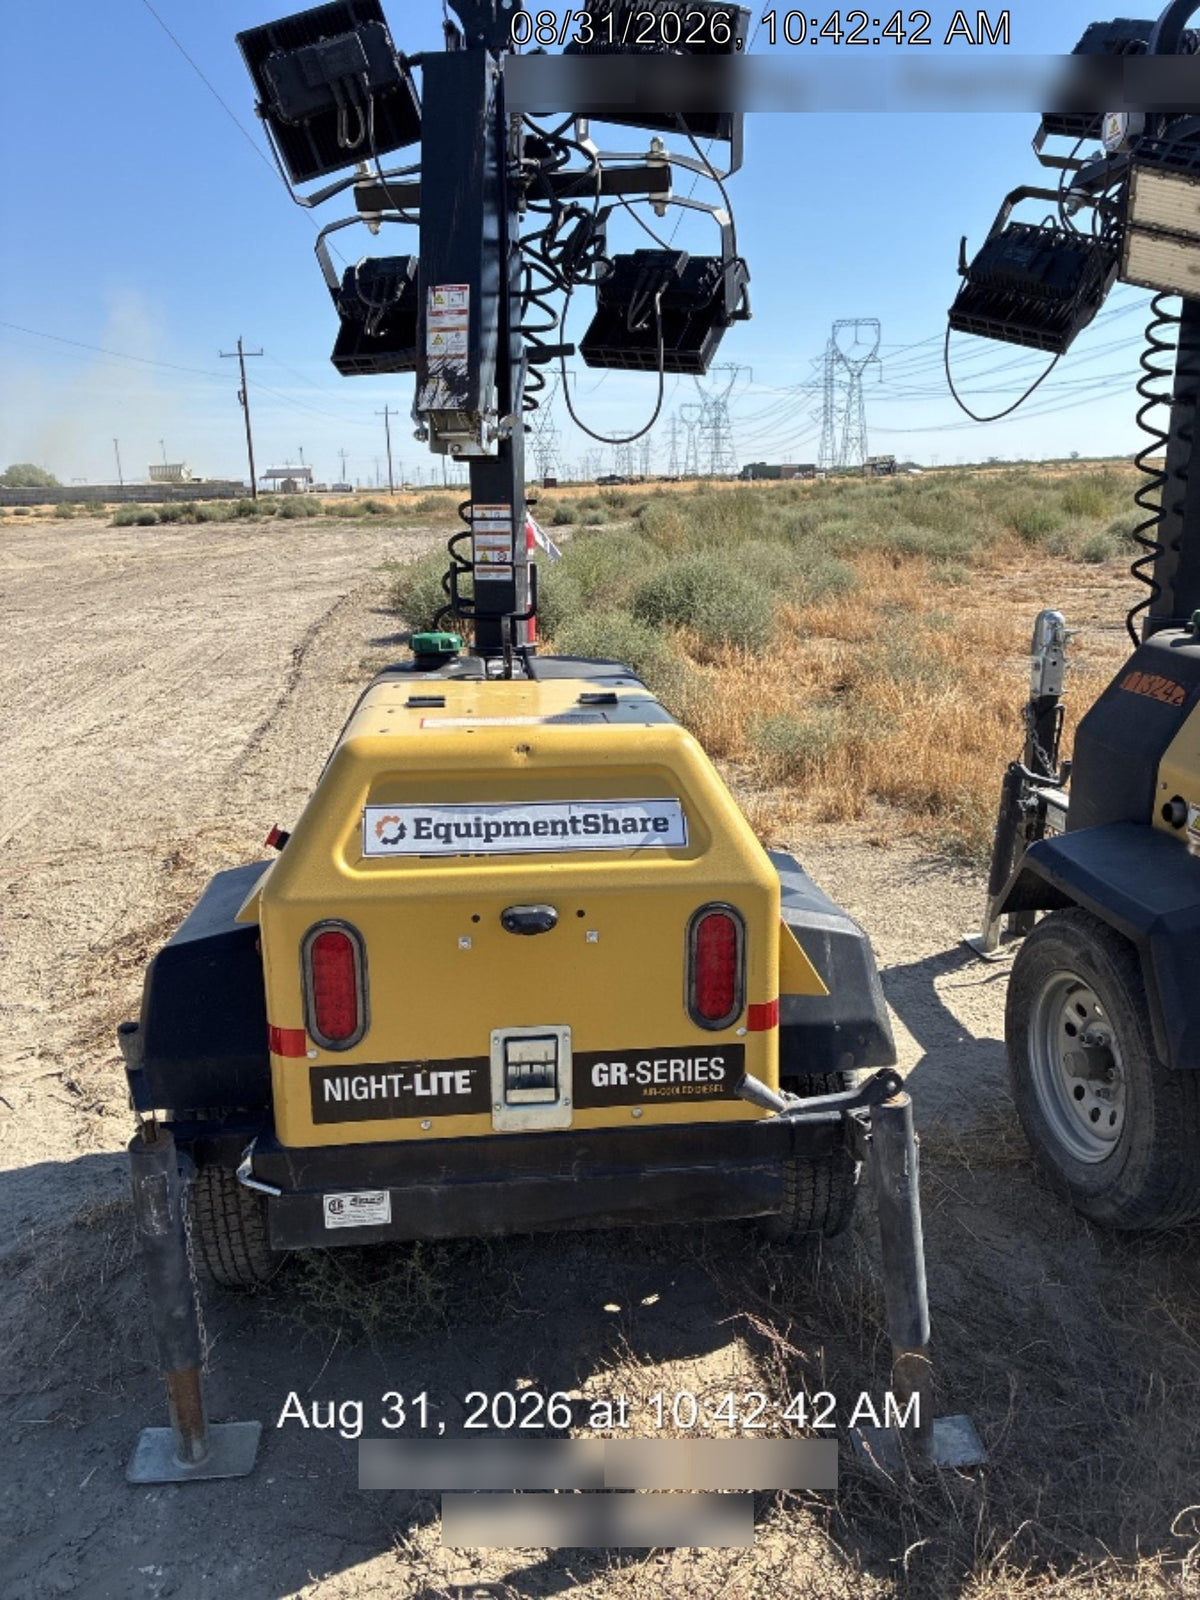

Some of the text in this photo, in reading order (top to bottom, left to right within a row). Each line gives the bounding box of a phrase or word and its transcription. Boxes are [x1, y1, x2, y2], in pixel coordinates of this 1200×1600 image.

[413, 812, 670, 843] EquipmentShare
[323, 1069, 472, 1102] NIGHT-LITE
[591, 1056, 726, 1087] GR-SERIES
